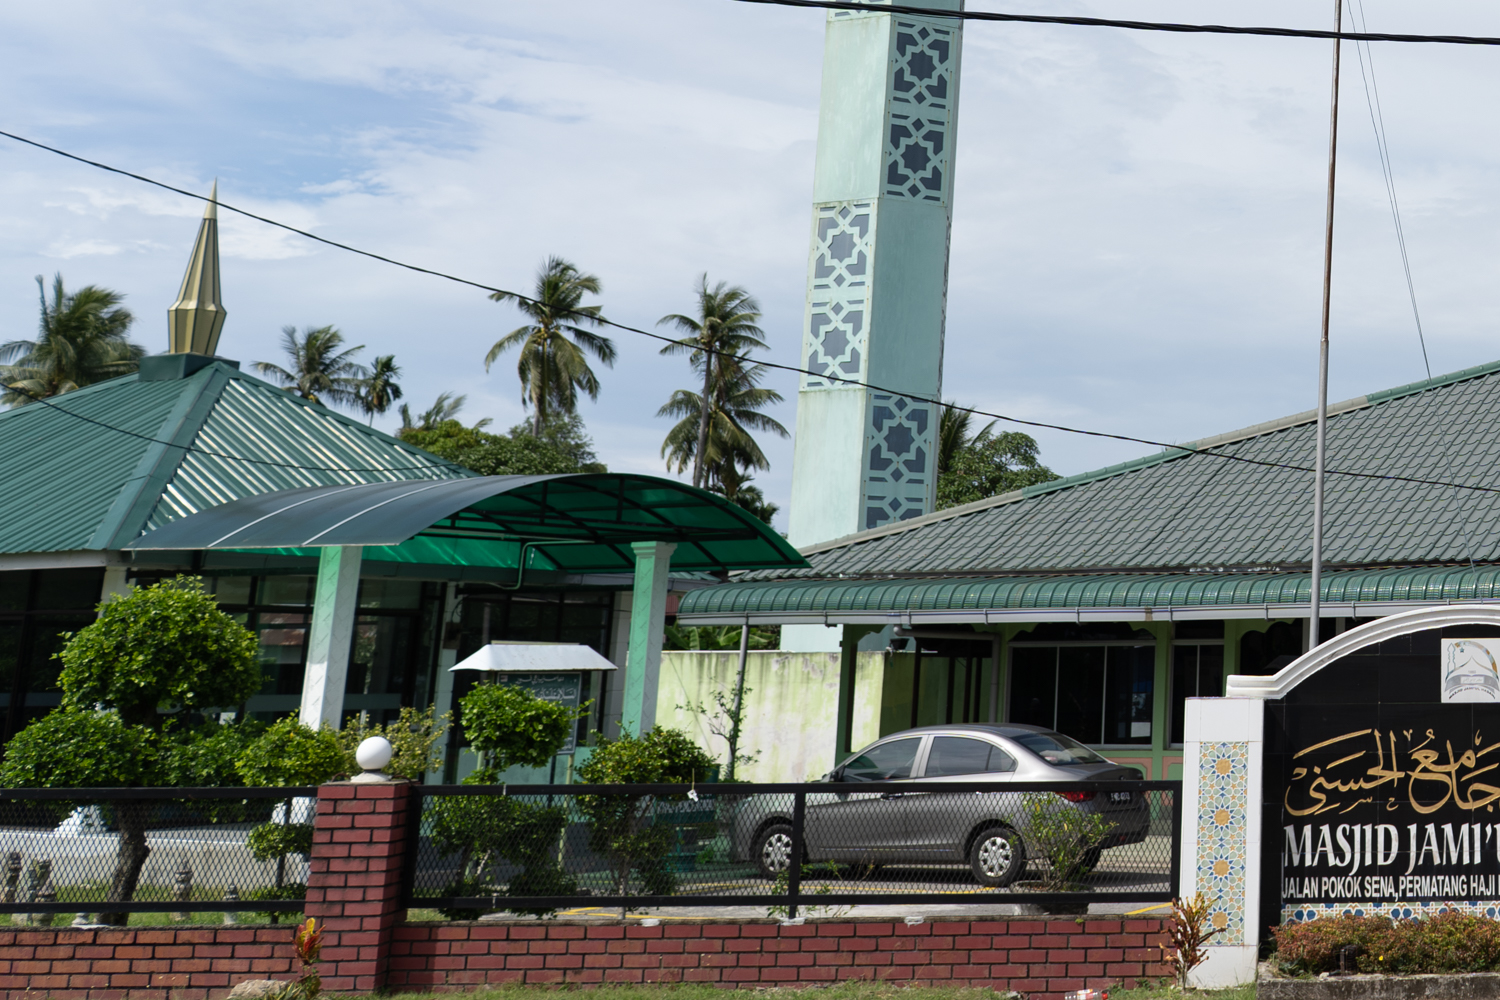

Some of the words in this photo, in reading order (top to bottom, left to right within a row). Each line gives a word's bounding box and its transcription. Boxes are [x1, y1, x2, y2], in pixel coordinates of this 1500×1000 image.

[1283, 823, 1399, 876] MASJID
[1282, 876, 1319, 899] JALAN
[1321, 875, 1362, 899] POKOK
[1399, 874, 1468, 898] PERMATANG
[1470, 873, 1496, 896] HAJI
